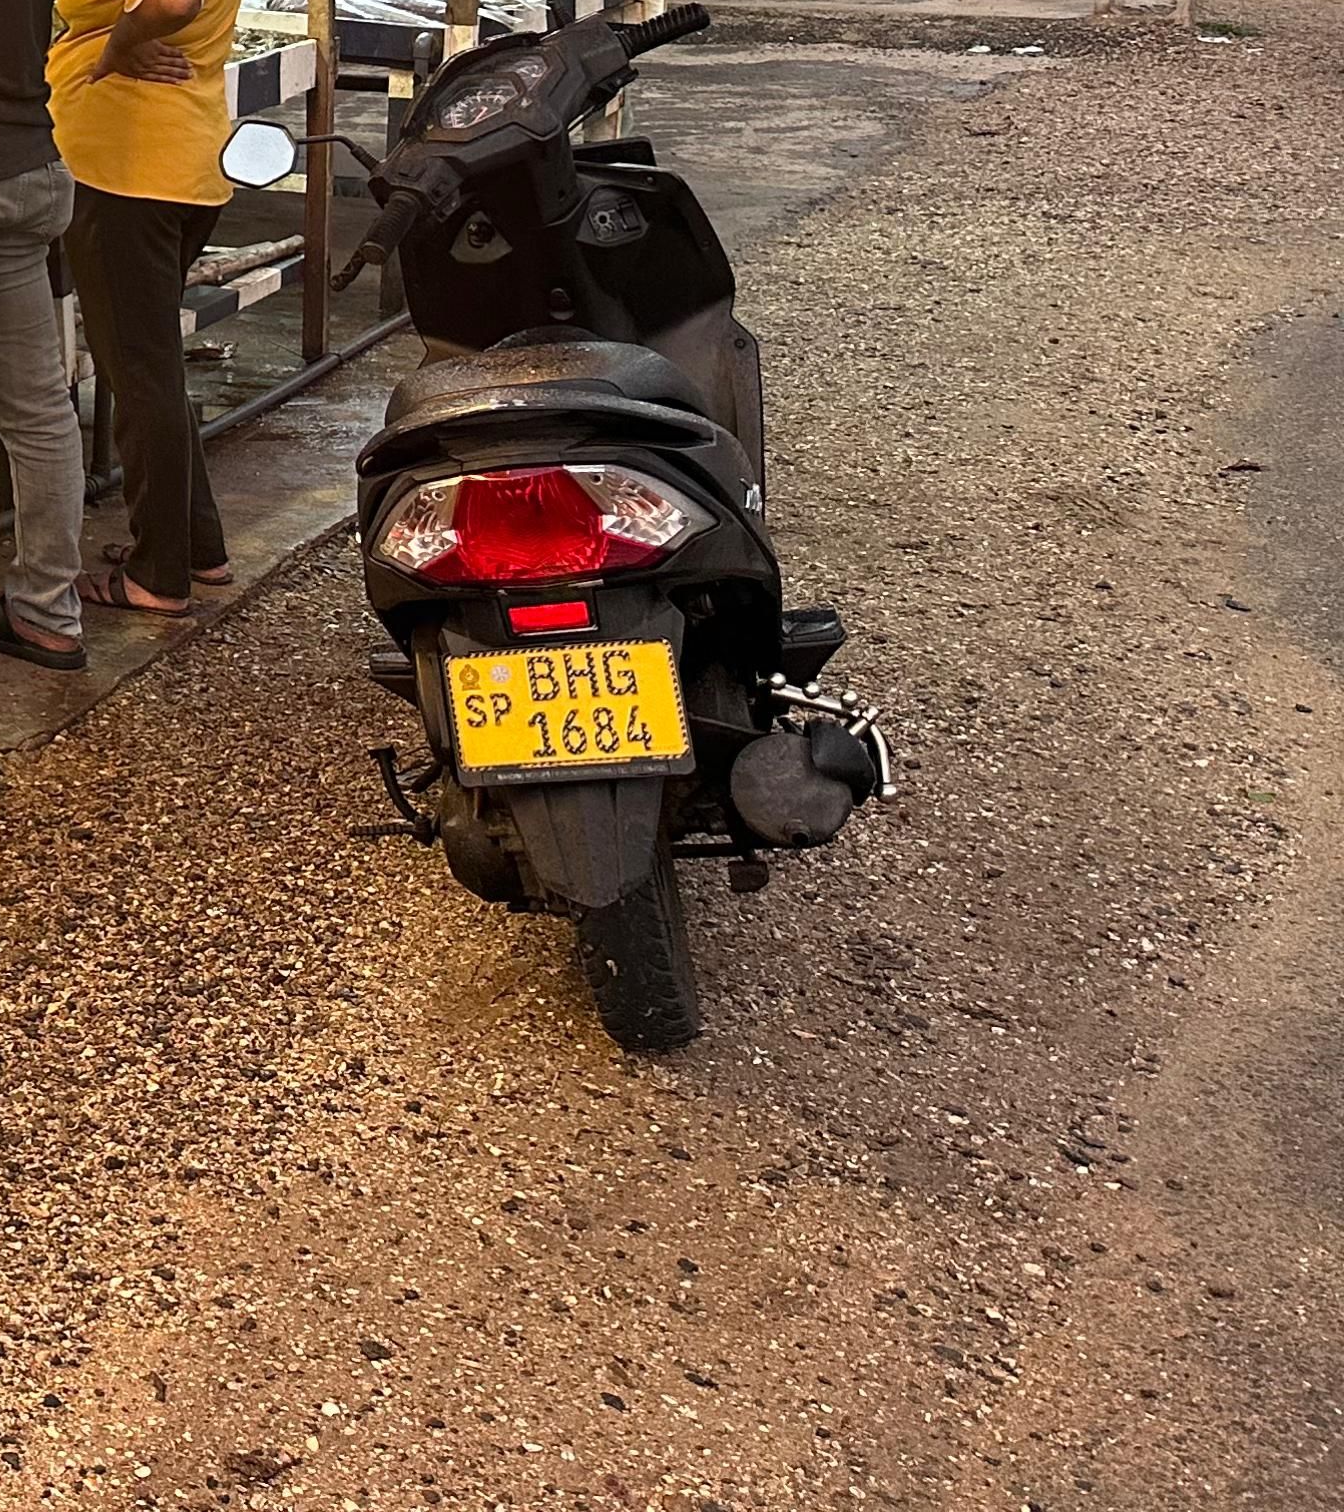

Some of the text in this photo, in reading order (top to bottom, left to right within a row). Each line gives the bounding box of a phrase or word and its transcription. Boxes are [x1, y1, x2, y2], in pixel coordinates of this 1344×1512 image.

[526, 649, 639, 703] BHG
[464, 692, 513, 729] SP
[527, 704, 653, 759] 1684
